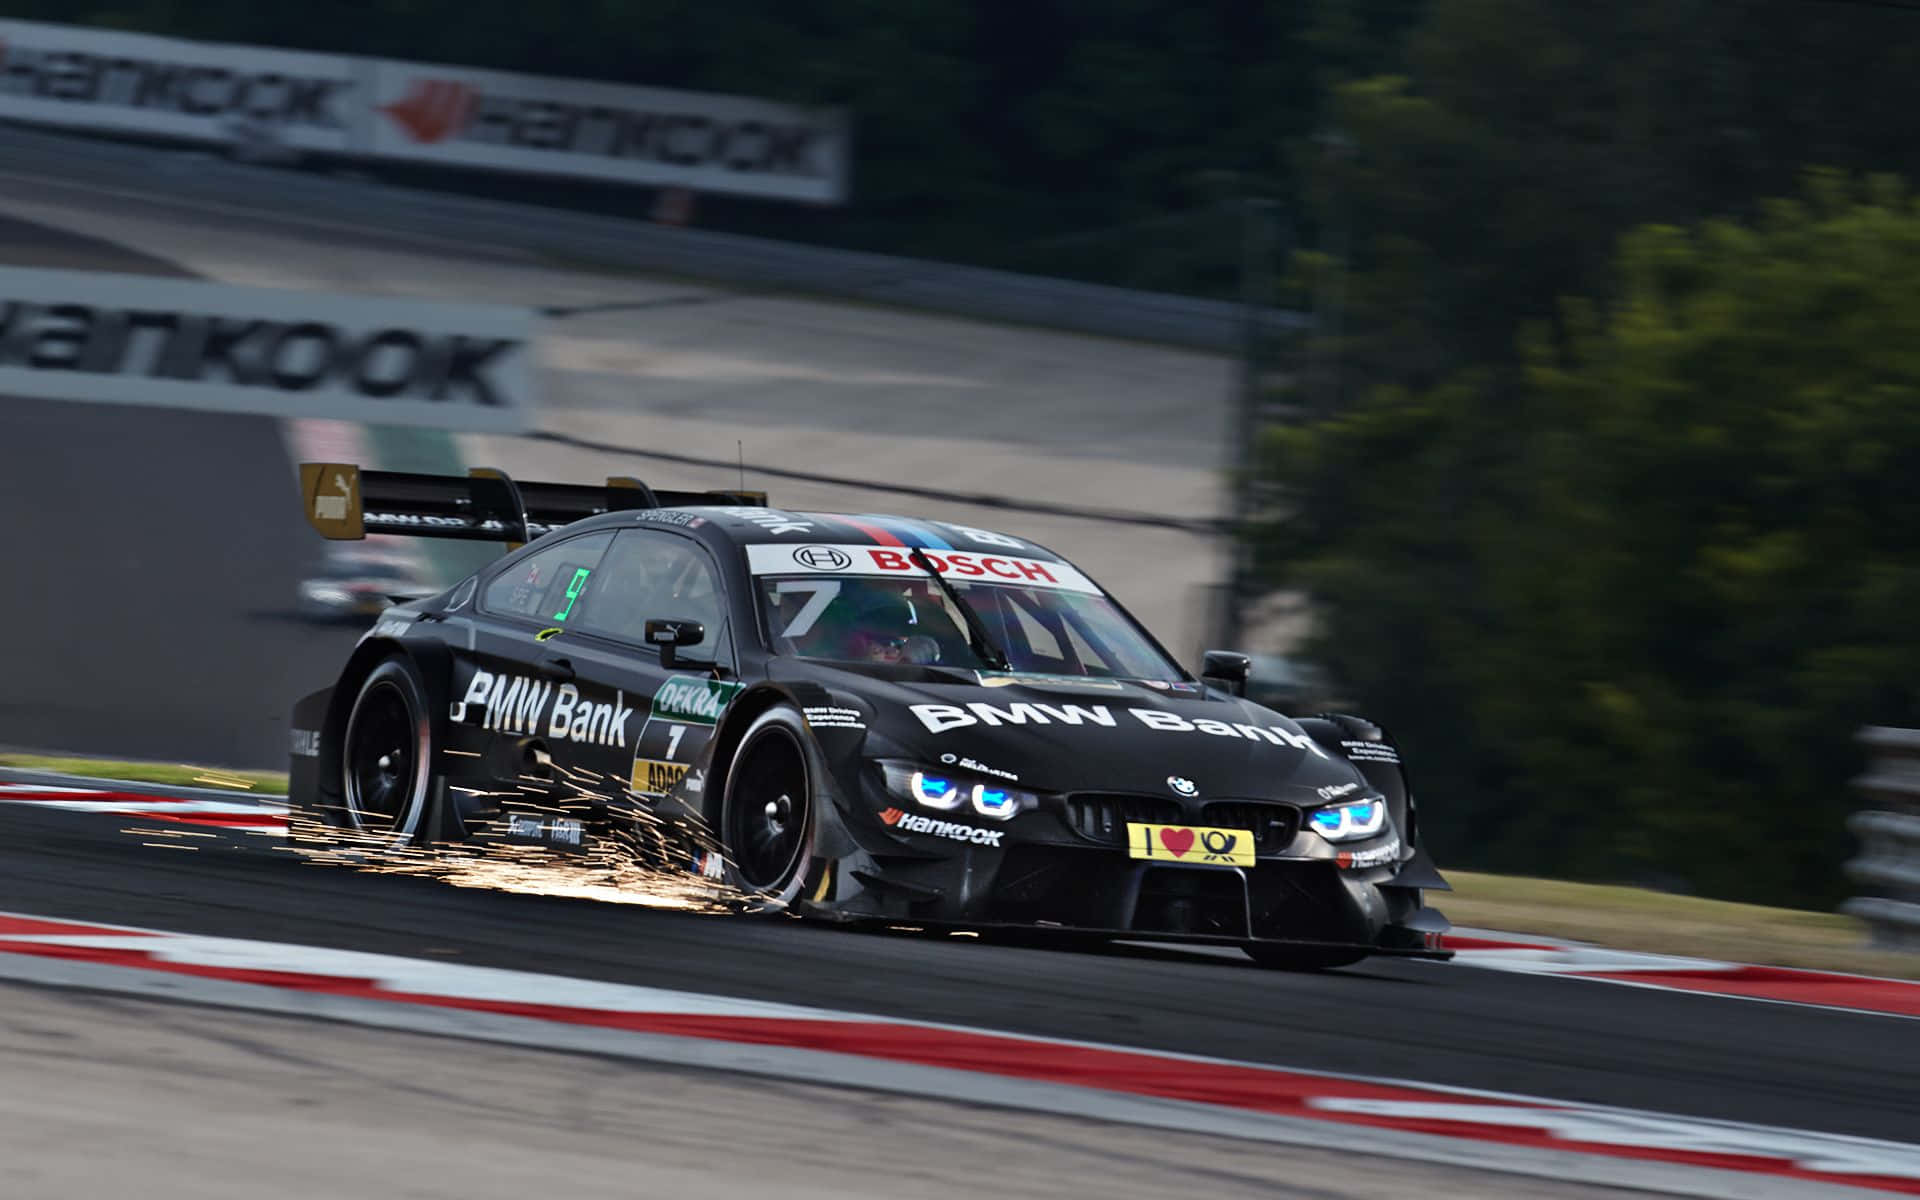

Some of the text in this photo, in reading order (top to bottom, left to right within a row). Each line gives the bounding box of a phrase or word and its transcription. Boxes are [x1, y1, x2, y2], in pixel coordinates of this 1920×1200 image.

[867, 549, 1059, 584] BOSCH
[781, 580, 841, 638] 7
[450, 670, 634, 748] BMW Bank
[660, 683, 722, 718] DEKRA
[908, 703, 1330, 760] BMW Bank
[1145, 827, 1152, 856] I
